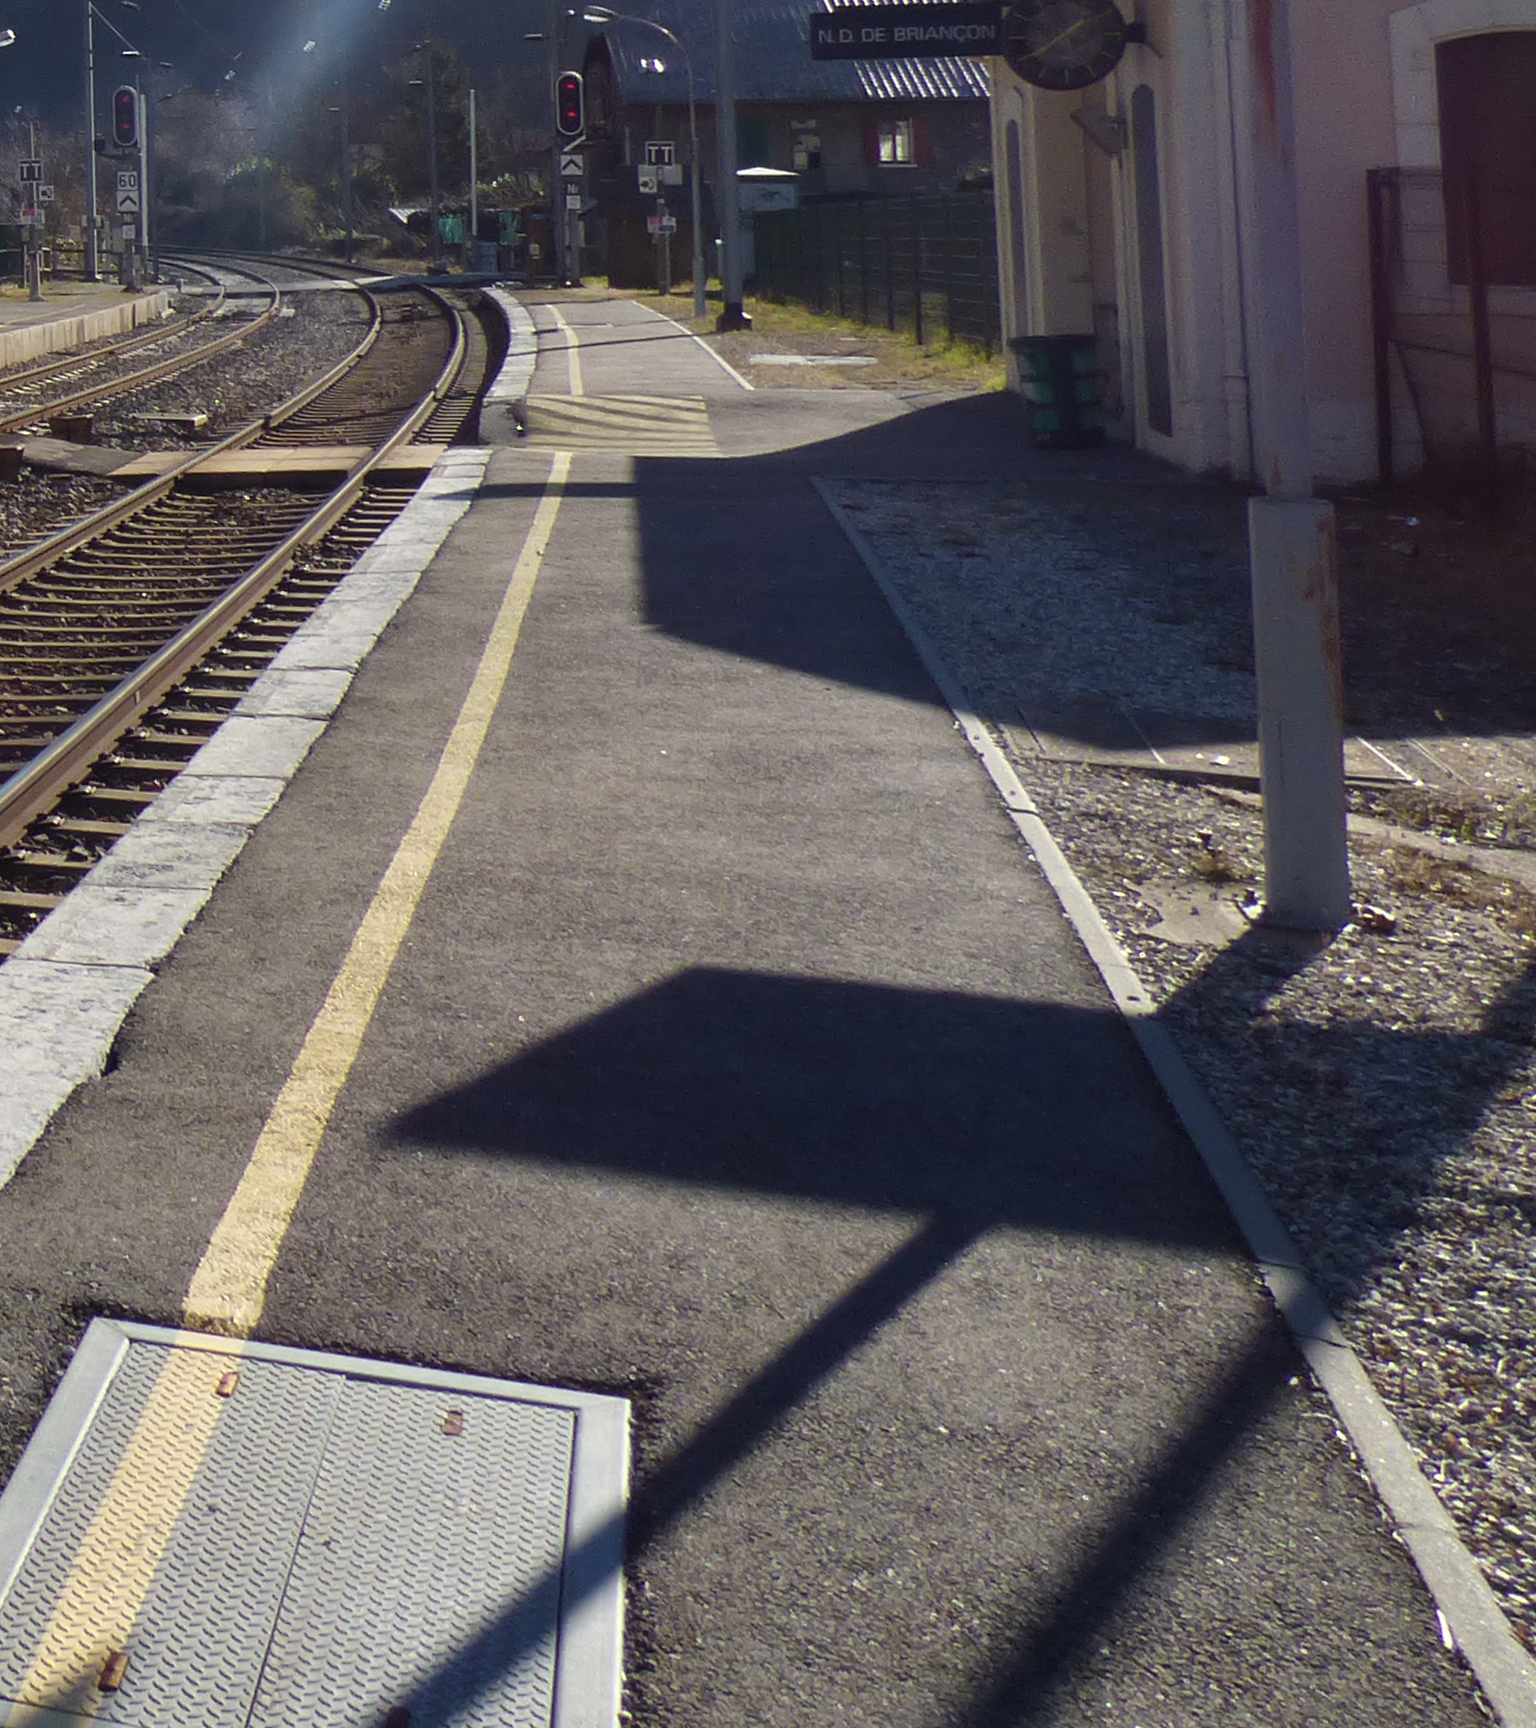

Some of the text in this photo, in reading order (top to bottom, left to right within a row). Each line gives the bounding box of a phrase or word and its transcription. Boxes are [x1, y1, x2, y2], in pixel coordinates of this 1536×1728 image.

[861, 27, 887, 43] DE
[893, 24, 995, 43] BRIANÇON
[648, 145, 671, 163] TT
[119, 174, 136, 188] 60
